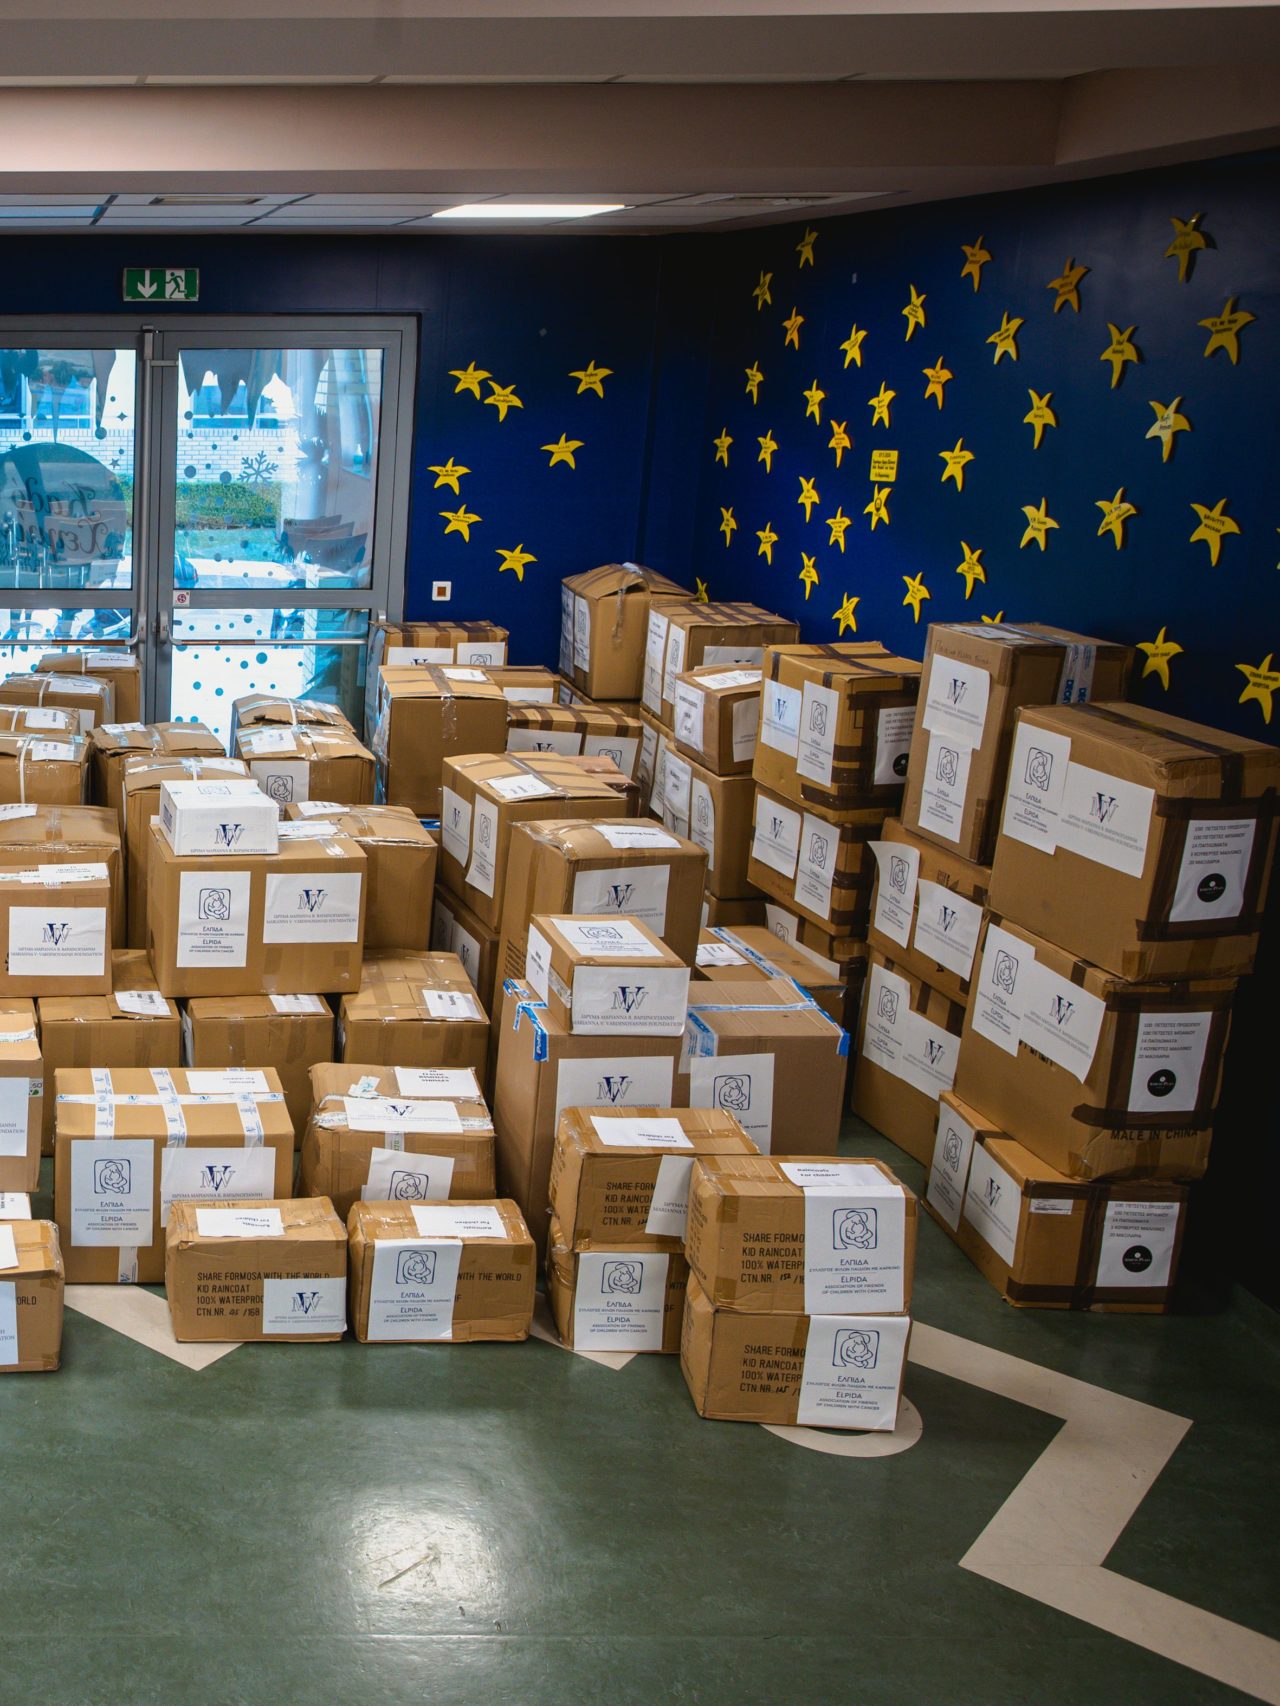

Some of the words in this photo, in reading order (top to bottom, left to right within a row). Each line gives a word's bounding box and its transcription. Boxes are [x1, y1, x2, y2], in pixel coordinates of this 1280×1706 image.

[1166, 1130, 1198, 1140] CHINA
[607, 1182, 632, 1190] SHARE
[605, 1194, 617, 1202] KID
[743, 1233, 771, 1243] SHARE
[742, 1248, 756, 1256] KID
[759, 1248, 802, 1257] RAINCOAT
[742, 1261, 763, 1270] 100%
[767, 1261, 805, 1270] WATERP
[197, 1272, 222, 1280] SHARE
[225, 1272, 262, 1280] FORMOSA
[197, 1285, 209, 1293] KID
[212, 1285, 249, 1293] RAINCOAT
[745, 1345, 772, 1355] SHARE
[743, 1358, 756, 1367] KID
[760, 1359, 803, 1371] RAINCOAT
[742, 1371, 763, 1380] 100%
